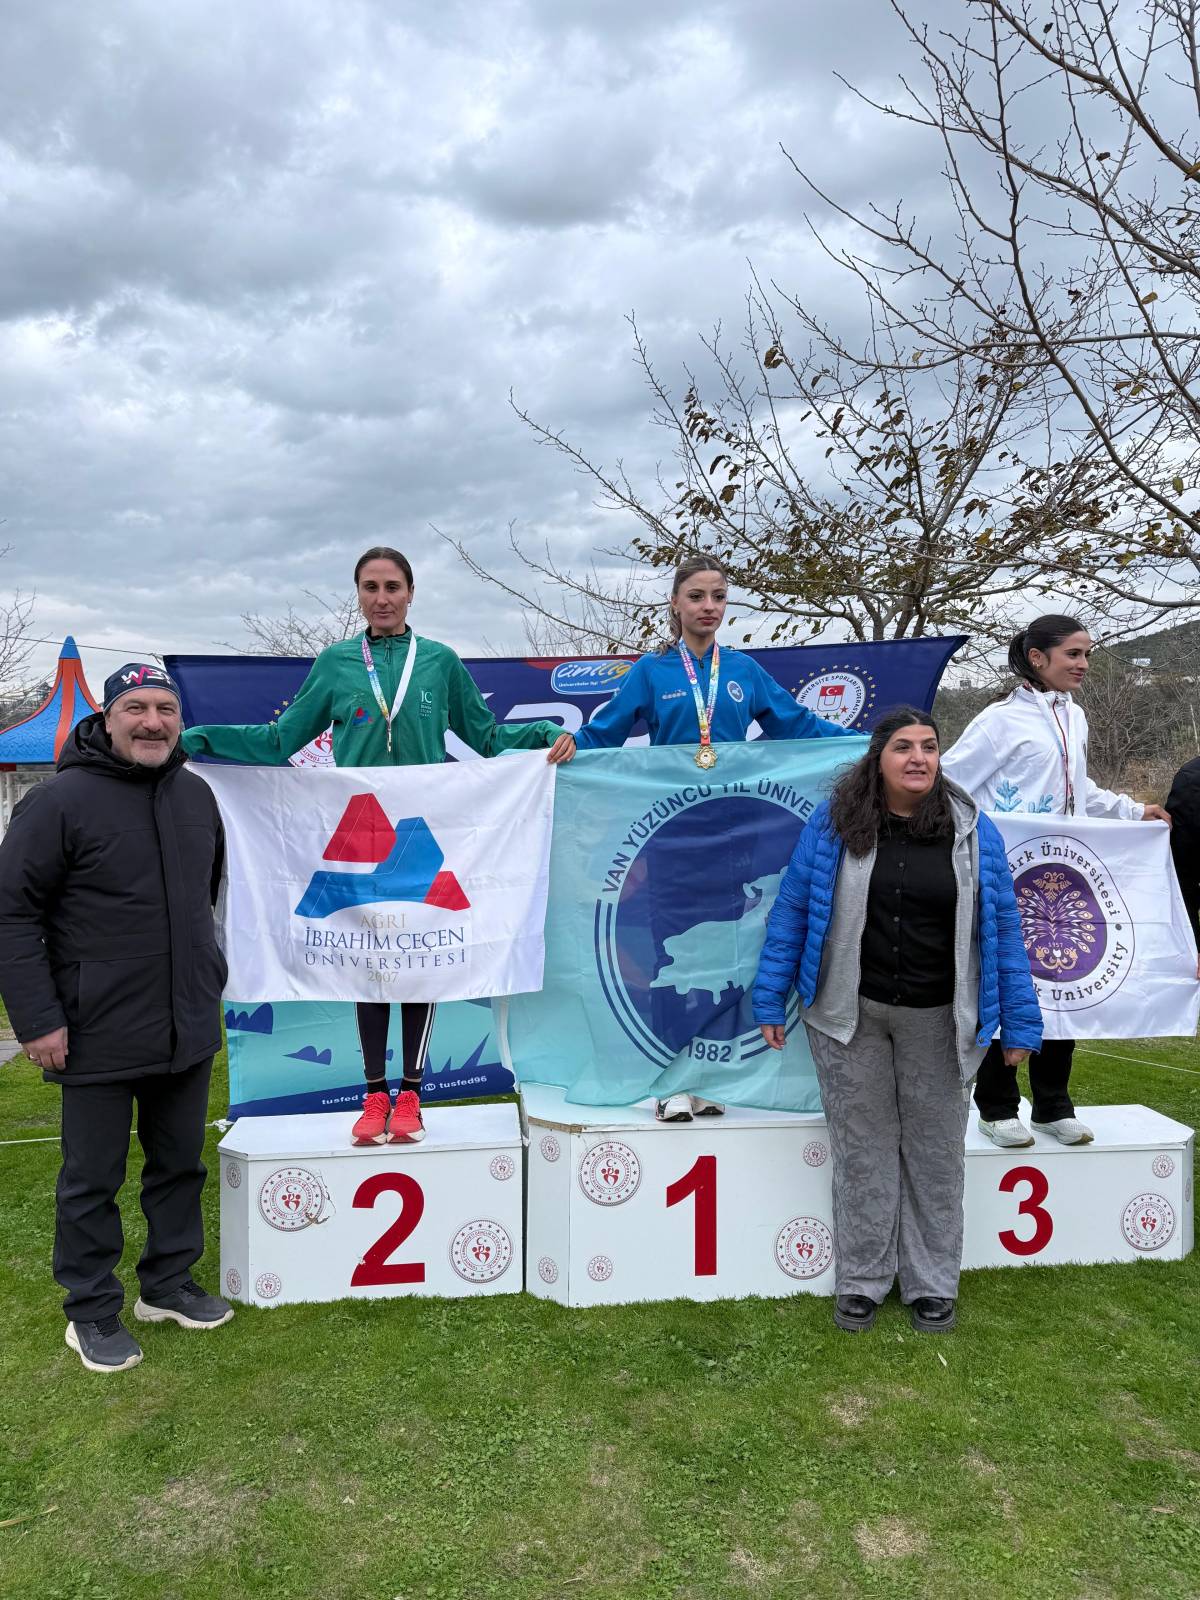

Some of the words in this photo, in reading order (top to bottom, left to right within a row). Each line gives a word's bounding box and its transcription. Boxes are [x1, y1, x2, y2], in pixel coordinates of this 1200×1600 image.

[602, 852, 632, 893] VAN
[758, 778, 815, 818] ÜNİVE
[1041, 842, 1121, 916] Üniversitesi
[305, 926, 390, 950] İBRAHİM
[397, 927, 465, 953] ÇEÇEN
[360, 913, 406, 929] AĞRI
[305, 949, 465, 970] ÜNİVERSİTESİ
[367, 971, 399, 984] 2007
[1052, 941, 1129, 1001] University
[688, 1040, 732, 1062] 1982
[321, 1094, 359, 1105] tusfed
[439, 1075, 488, 1089] tusfed96
[351, 1173, 425, 1287] 2
[667, 1156, 717, 1275] 1
[999, 1167, 1052, 1255] 3
